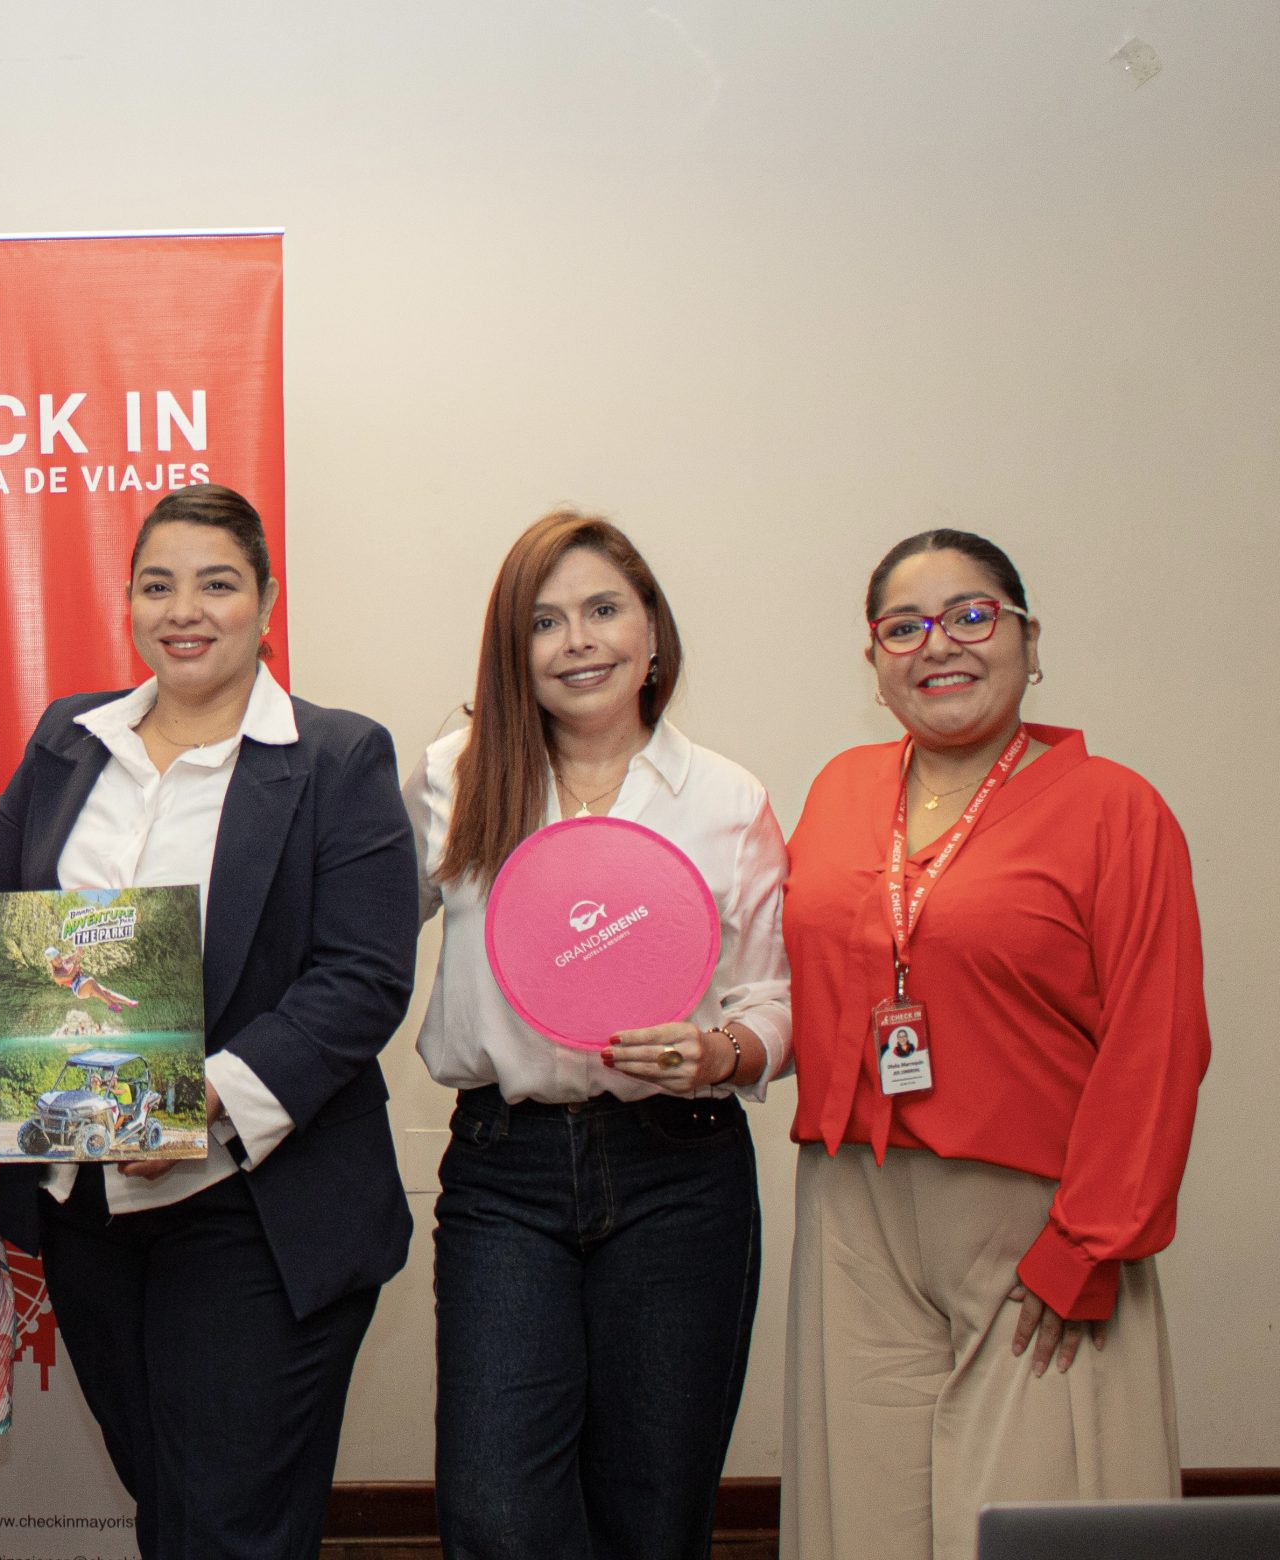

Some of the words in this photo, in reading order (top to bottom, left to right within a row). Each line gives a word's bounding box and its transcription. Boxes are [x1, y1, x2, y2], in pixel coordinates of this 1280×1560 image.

[126, 389, 208, 453] IN
[24, 466, 68, 495] DE
[81, 462, 210, 493] VIAJES
[969, 788, 990, 814] CHECK
[933, 842, 955, 869] CHECK
[890, 893, 904, 927] CHECK
[75, 929, 98, 945] THE
[555, 905, 649, 968] GRANDSIRENIS
